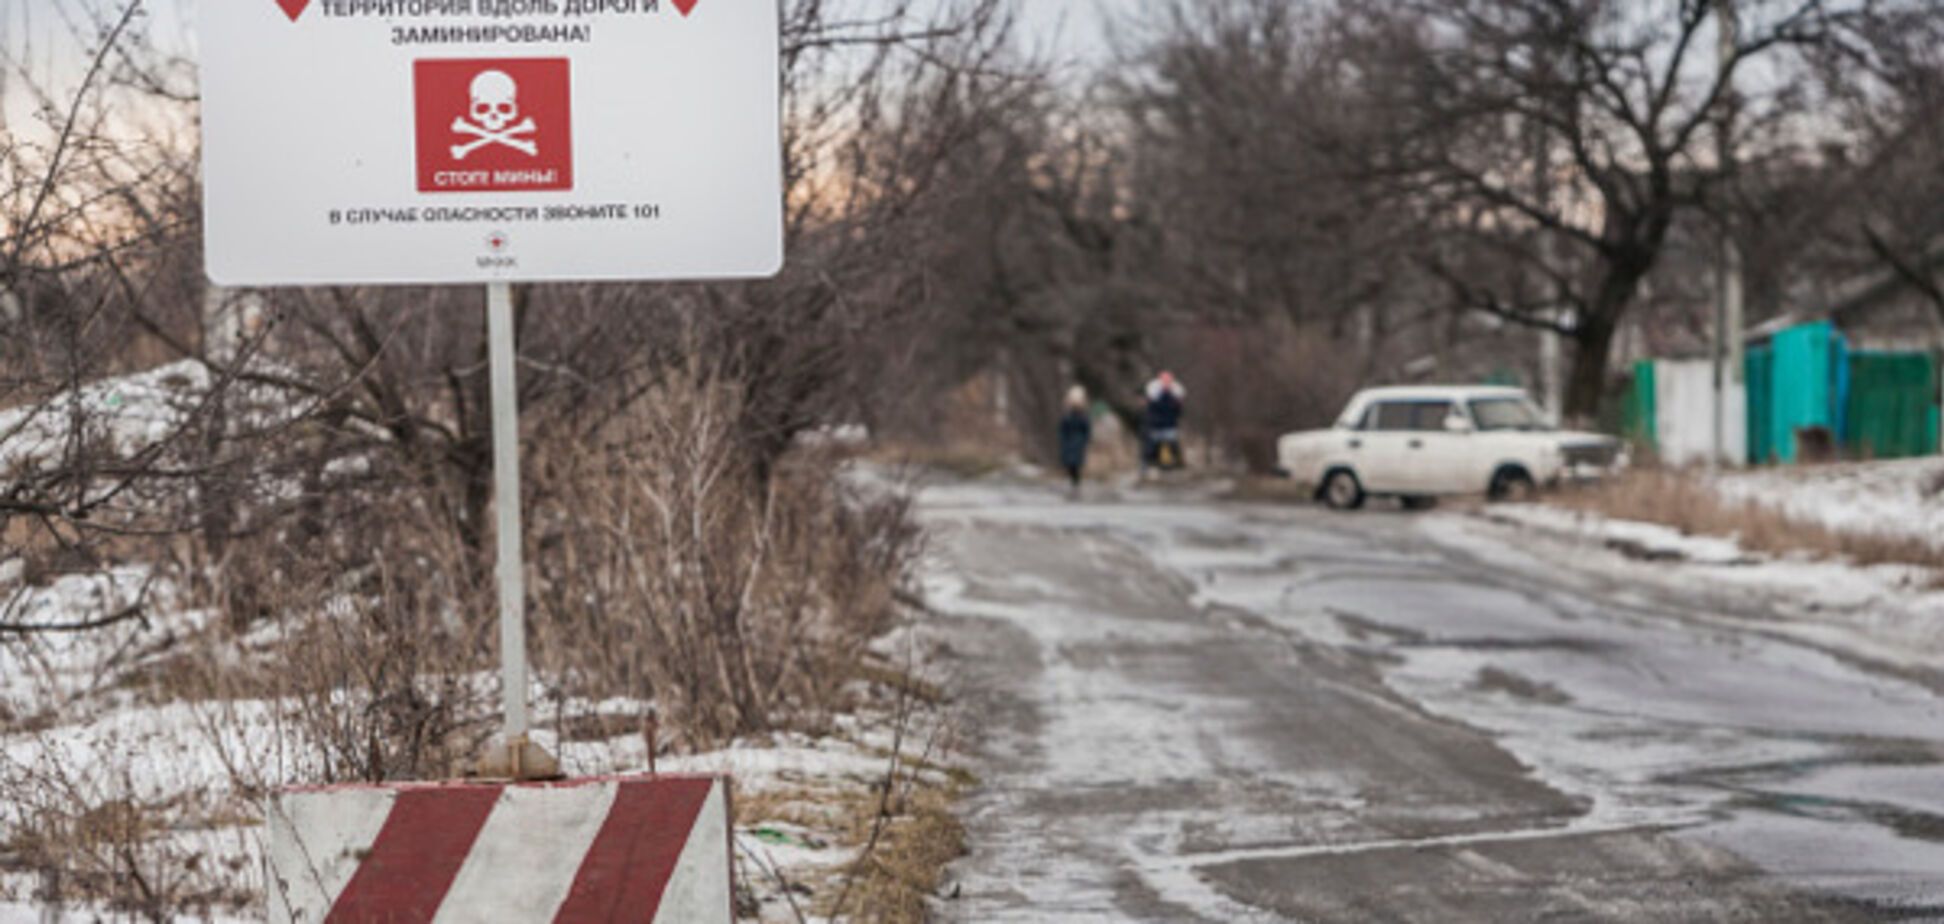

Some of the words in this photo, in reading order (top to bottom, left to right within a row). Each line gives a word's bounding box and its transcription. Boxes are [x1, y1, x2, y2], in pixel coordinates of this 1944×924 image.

[321, 0, 471, 16] ТЕРРИТОРИЯ
[477, 0, 558, 17] ВДОЛЬ
[563, 0, 659, 16] ДОРОГИ
[391, 25, 591, 45] ЗАМИНИРОВАНА!
[493, 169, 558, 184] МИНЫ!
[329, 209, 341, 224] В
[346, 208, 418, 223] СЛУЧАЕ
[422, 206, 539, 222] ОПАСНОСТИ
[543, 204, 627, 220] ЗВОНИТЕ
[634, 204, 660, 218] 101
